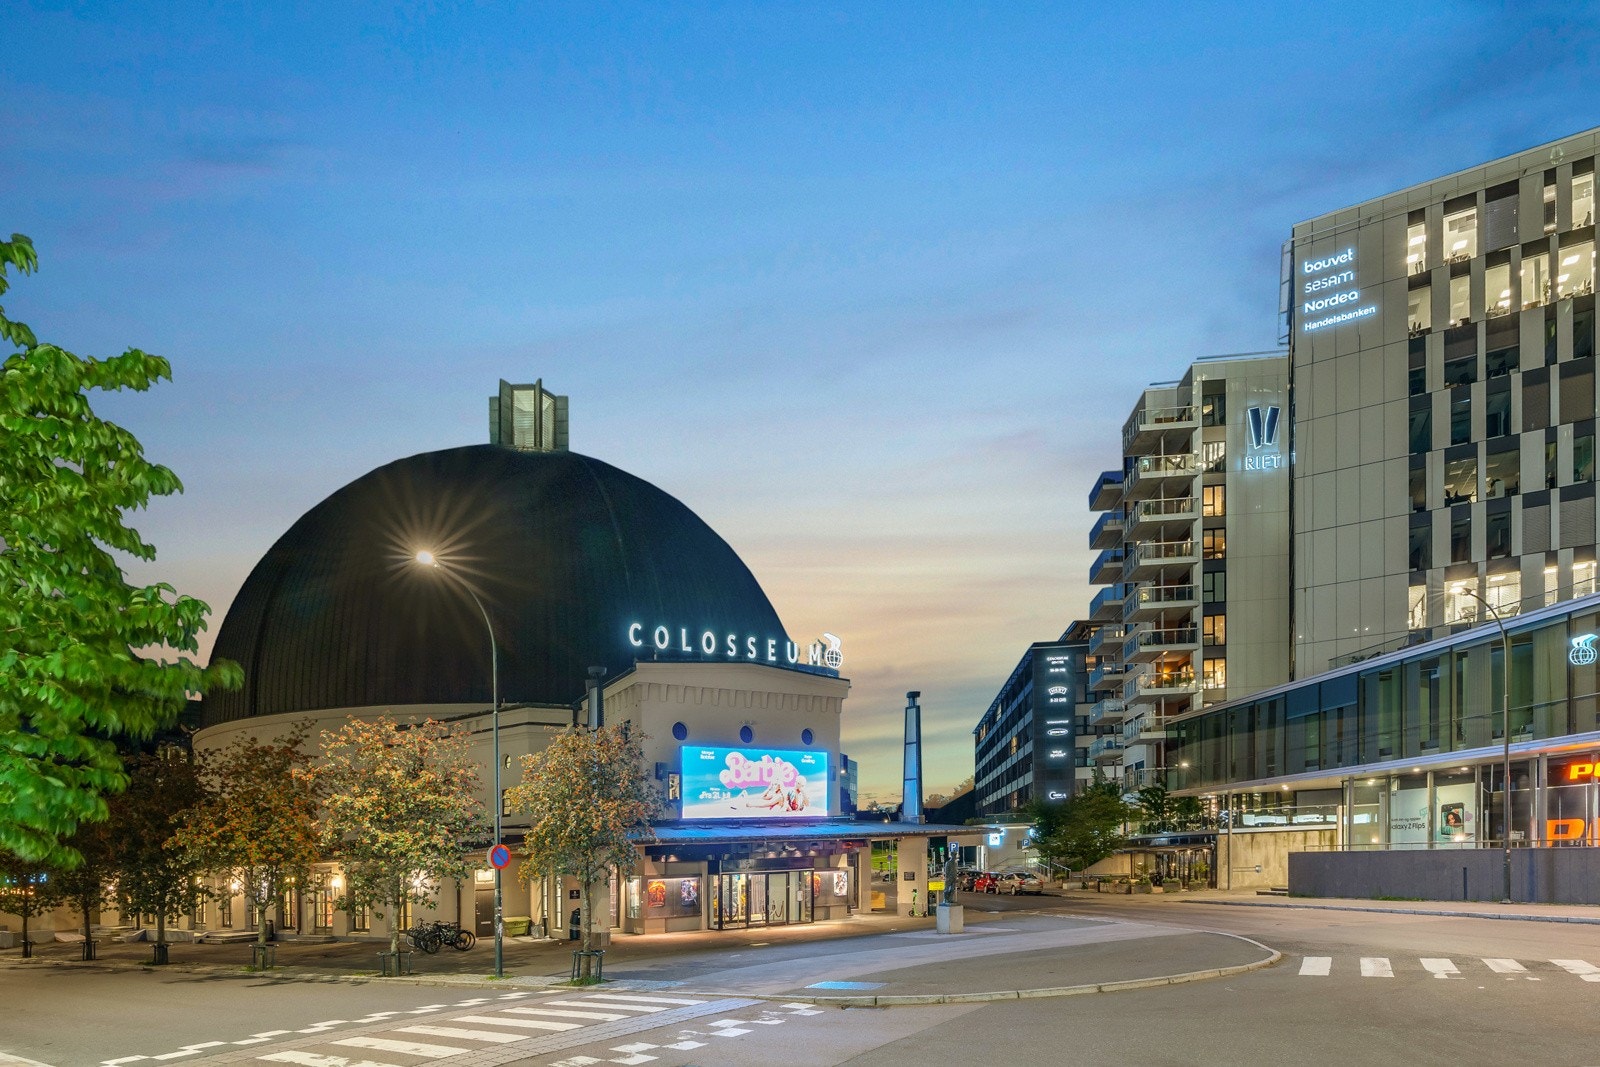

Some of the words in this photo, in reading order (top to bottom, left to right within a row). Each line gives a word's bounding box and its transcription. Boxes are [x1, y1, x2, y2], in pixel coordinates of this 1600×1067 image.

[1304, 248, 1353, 273] bouvet
[1304, 291, 1359, 313] Nordea
[1304, 306, 1376, 331] Handelsbanken
[1245, 455, 1281, 470] RIFT
[629, 623, 822, 665] COLOSSEUM
[719, 752, 799, 789] Barbie
[1569, 762, 1600, 780] P
